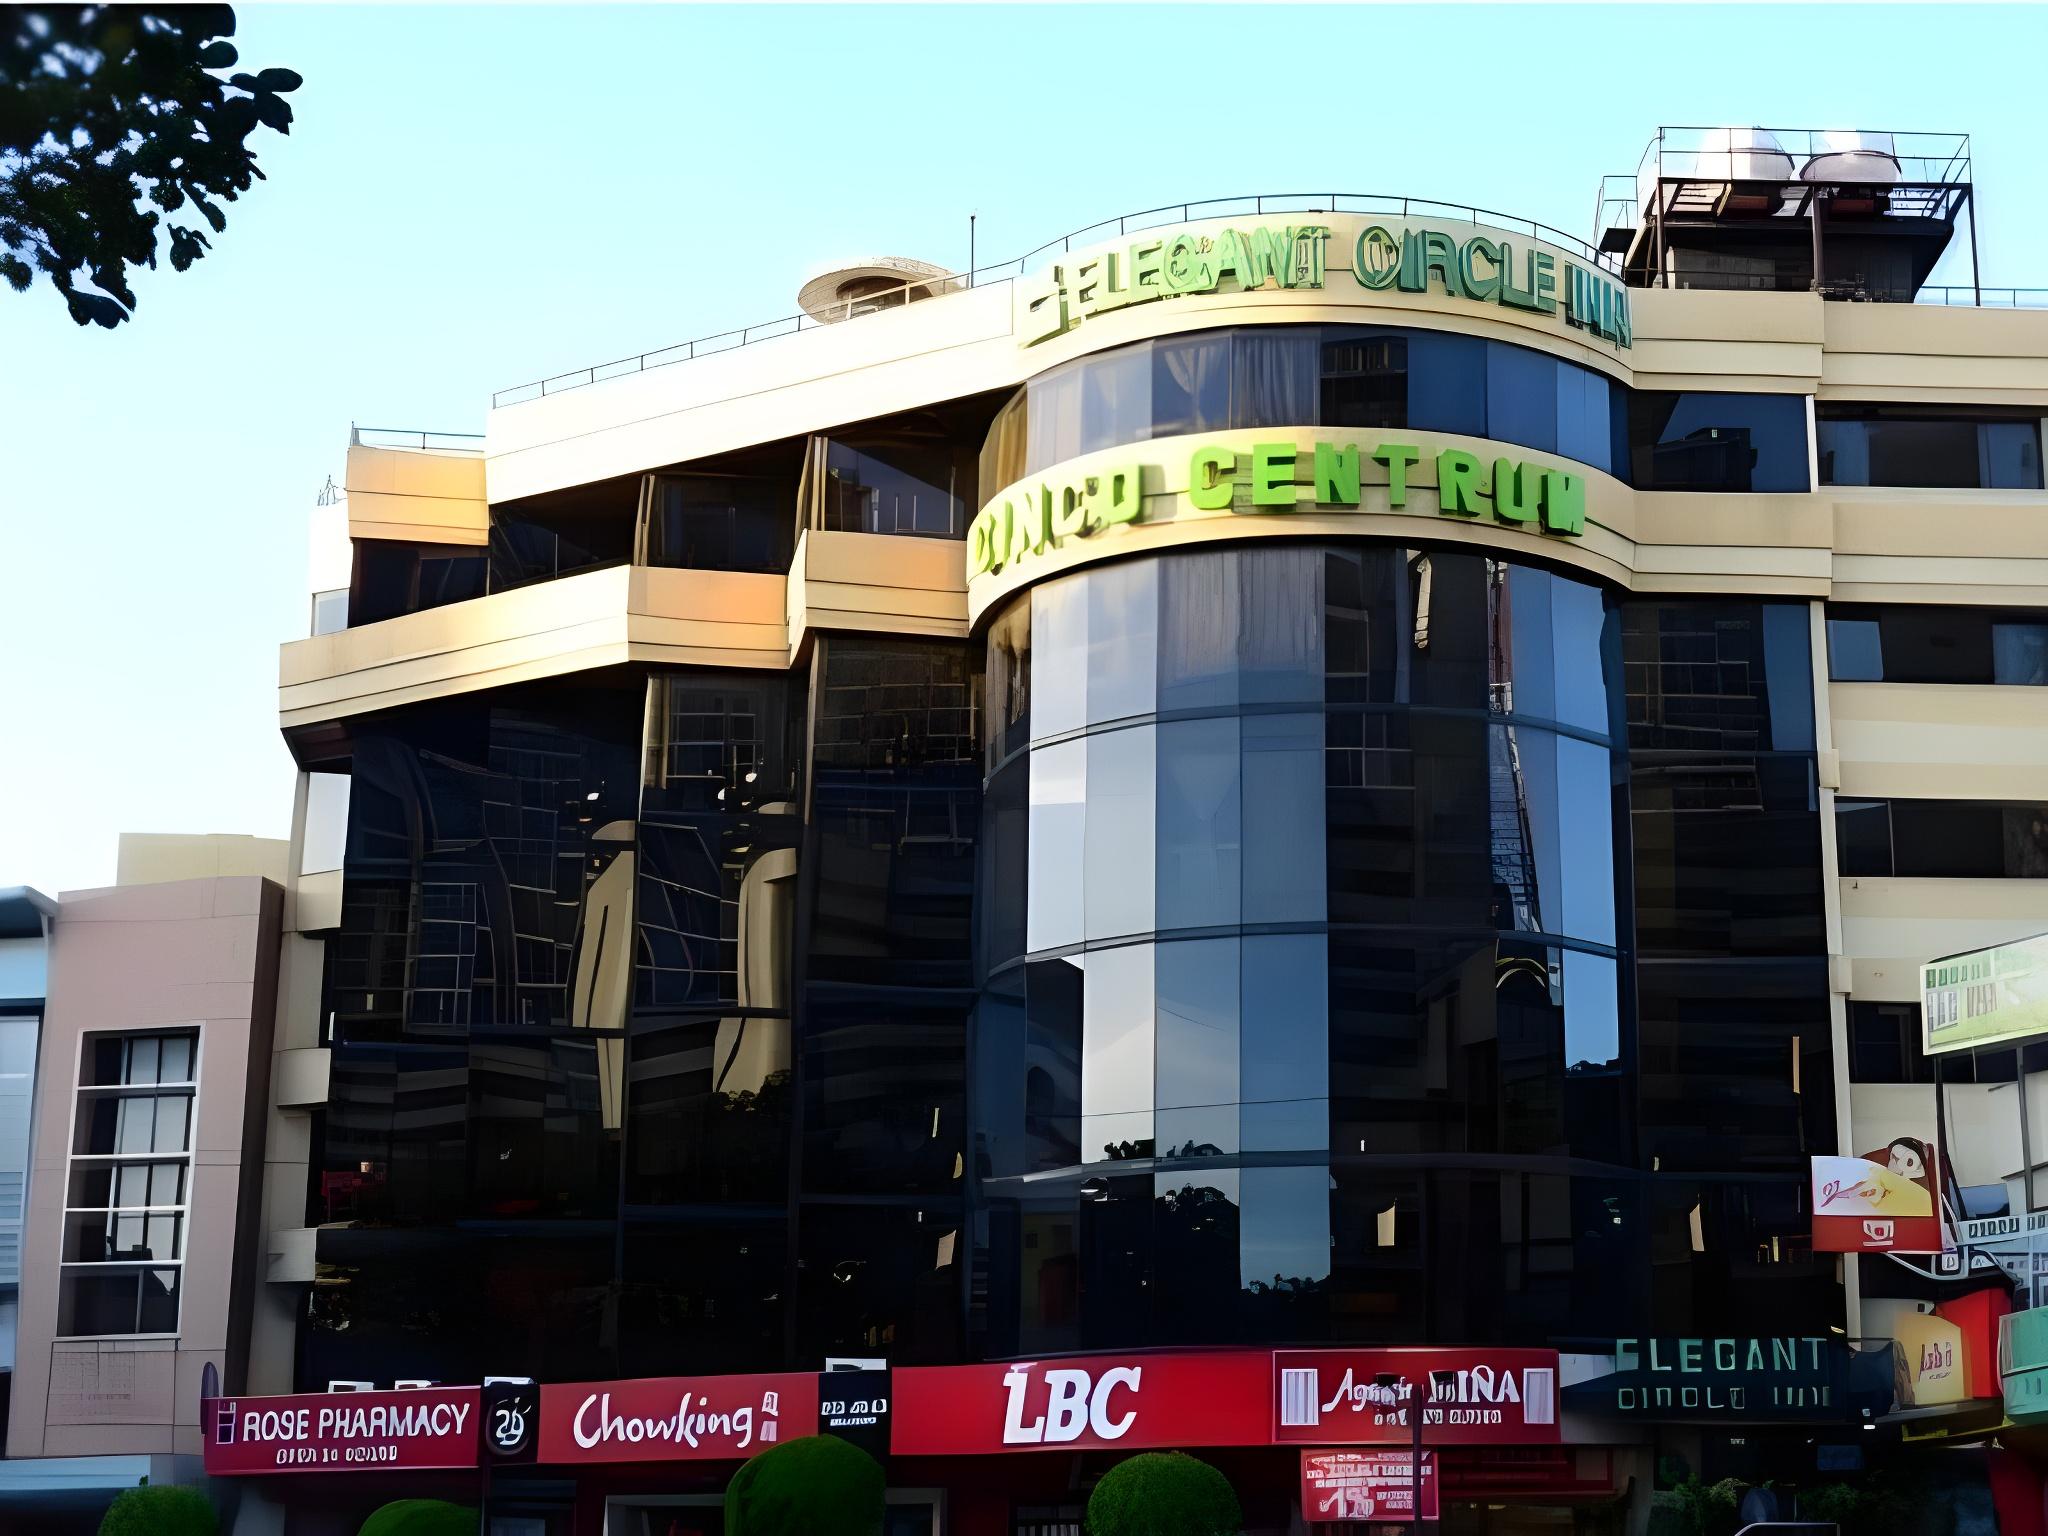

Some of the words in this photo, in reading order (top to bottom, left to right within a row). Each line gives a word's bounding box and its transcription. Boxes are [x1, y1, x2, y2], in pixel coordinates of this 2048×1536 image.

[1189, 441, 1586, 538] CENTRUM
[317, 1402, 471, 1440] PHARMACY
[573, 1392, 753, 1448] Chowking
[1002, 1361, 1142, 1444] LBC
